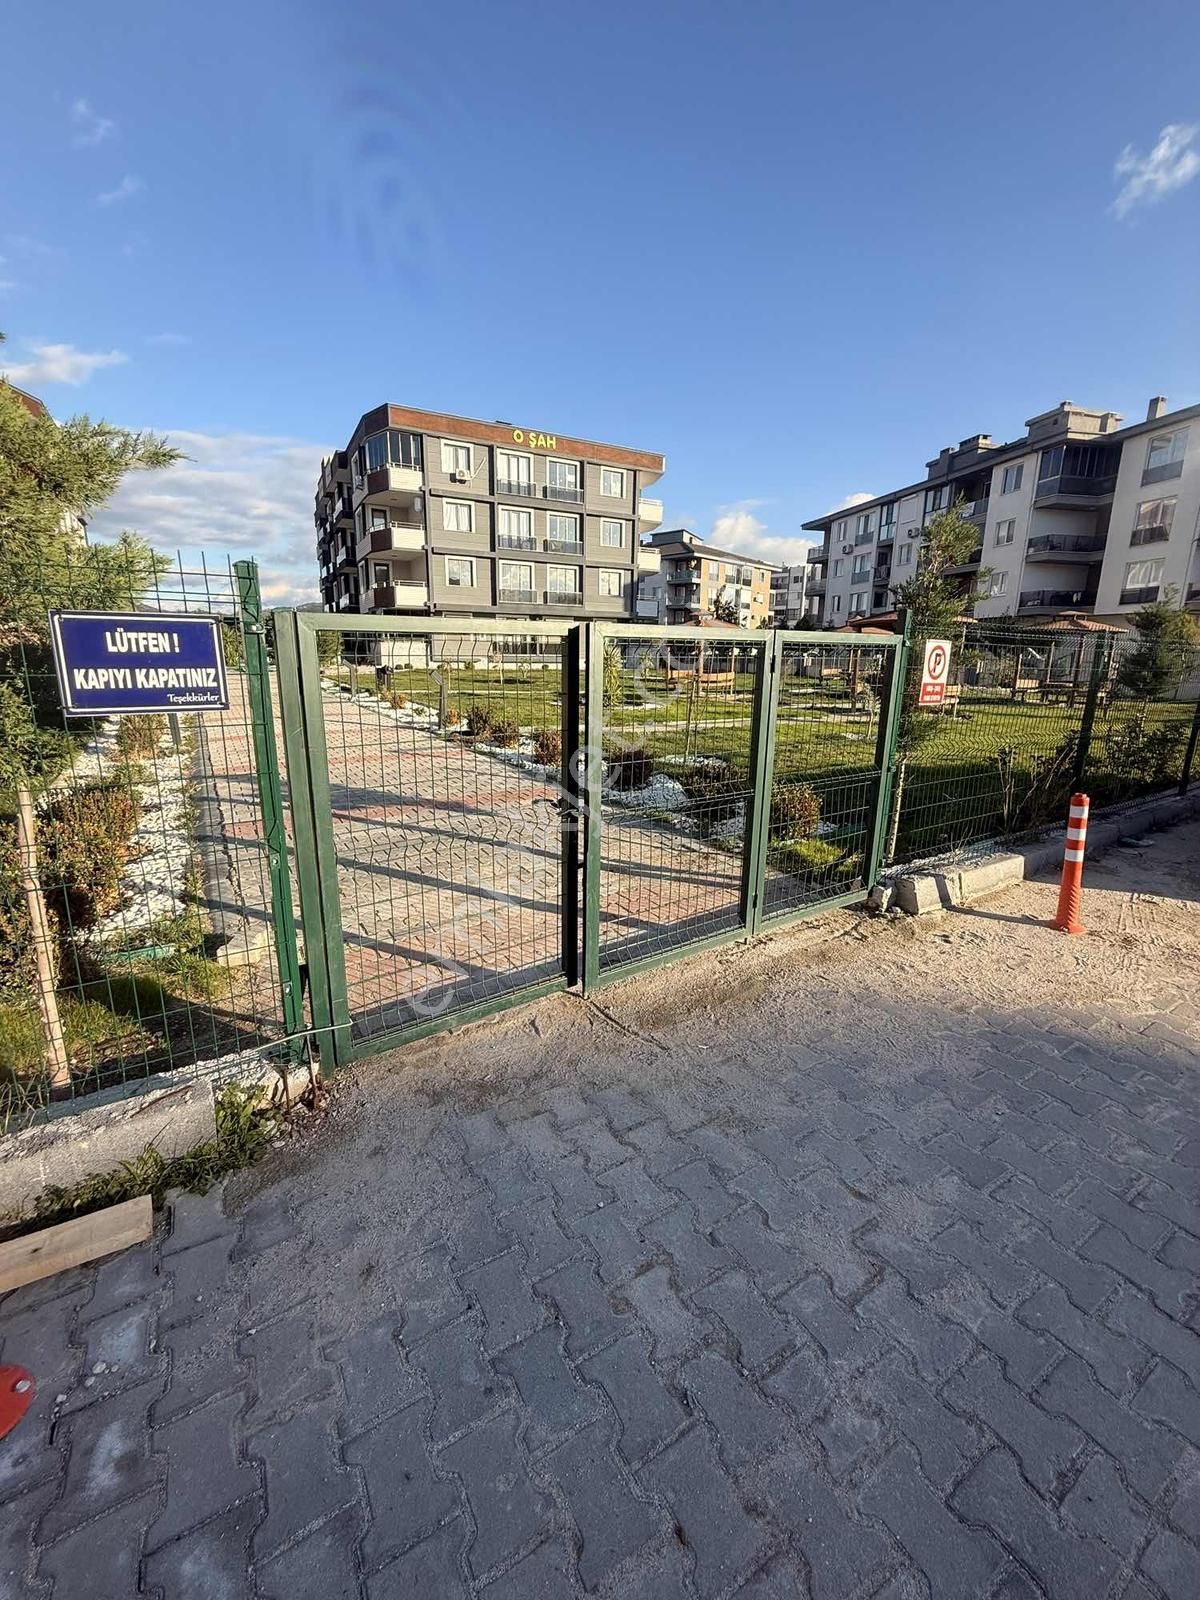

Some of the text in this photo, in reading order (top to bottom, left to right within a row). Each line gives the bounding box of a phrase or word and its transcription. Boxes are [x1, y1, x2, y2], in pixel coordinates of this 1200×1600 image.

[528, 433, 557, 450] ŞAH
[105, 628, 172, 653] LÜTFEN
[73, 668, 218, 690] KAPIYI KAPATINIZ
[167, 691, 220, 704] Teşekkürler
